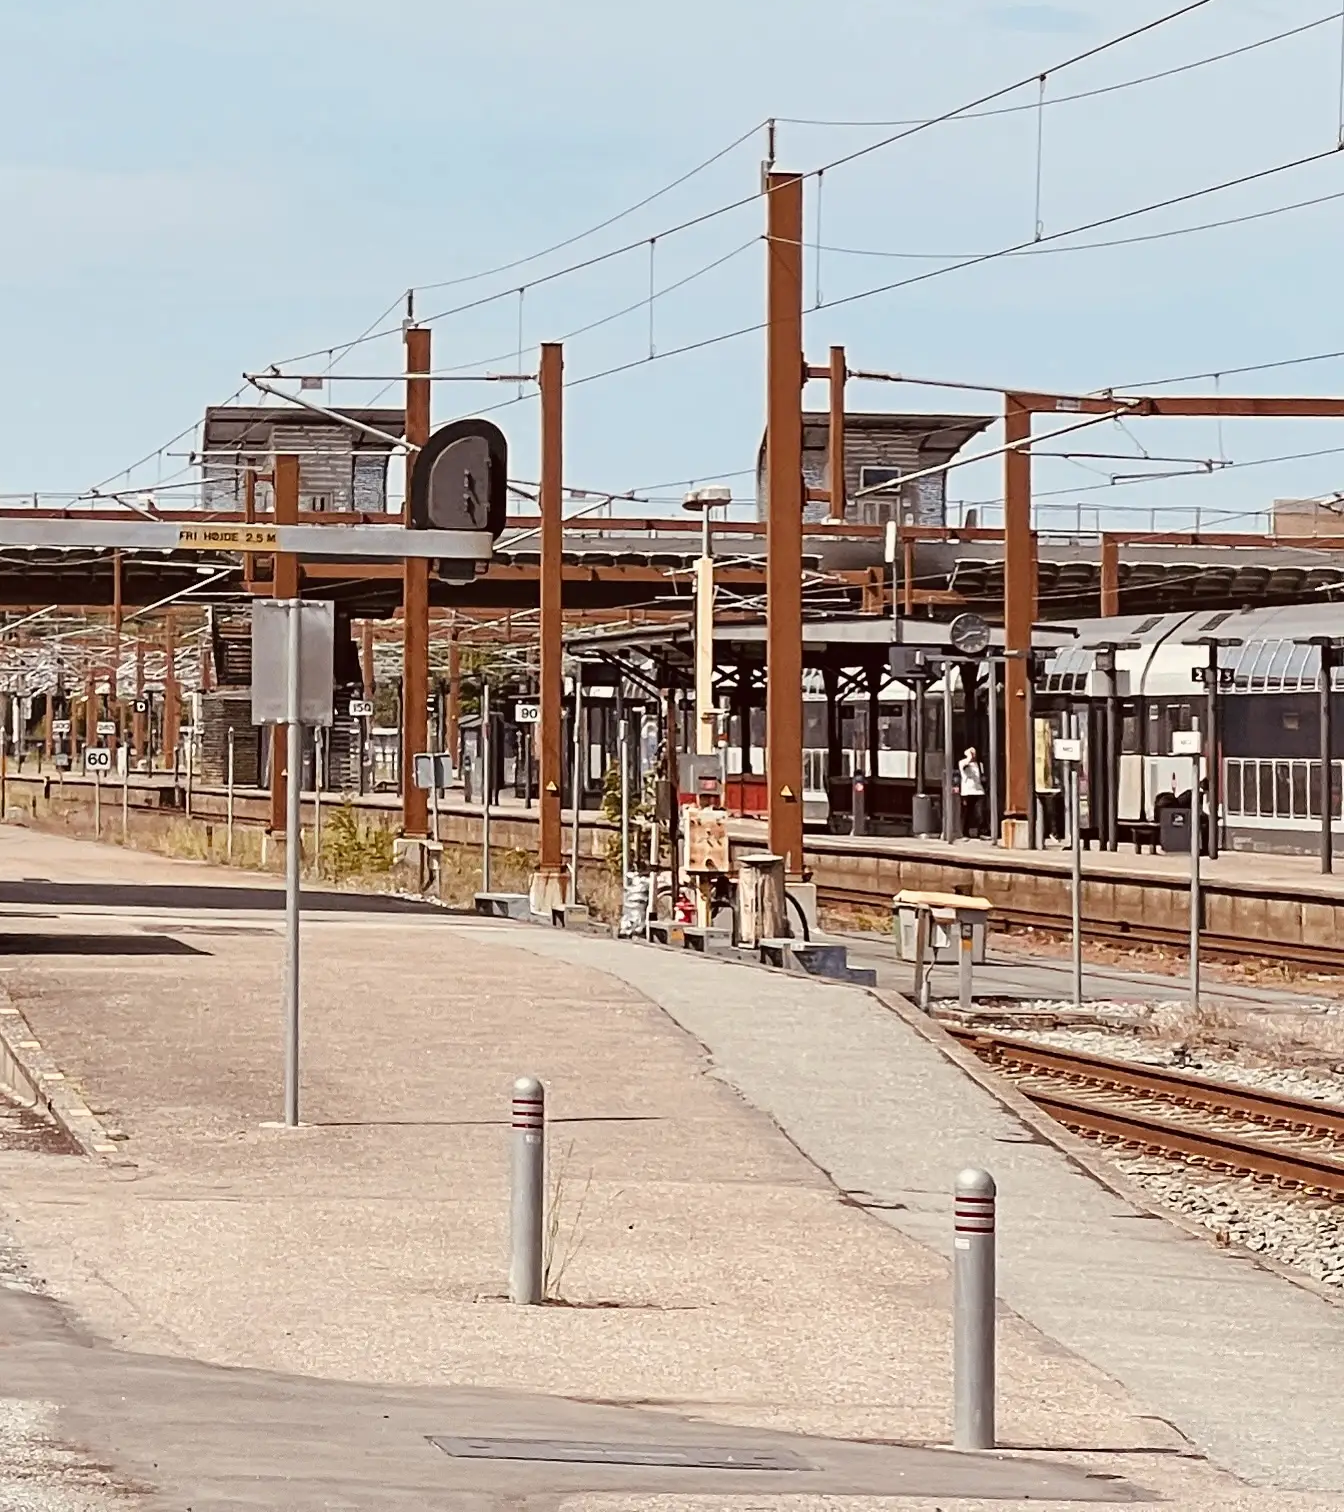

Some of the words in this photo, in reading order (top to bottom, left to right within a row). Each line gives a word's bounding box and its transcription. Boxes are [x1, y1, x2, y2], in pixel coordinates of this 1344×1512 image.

[179, 531, 197, 541] FRI
[204, 532, 238, 542] HØJDE
[267, 533, 276, 543] M
[88, 753, 109, 765] 60
